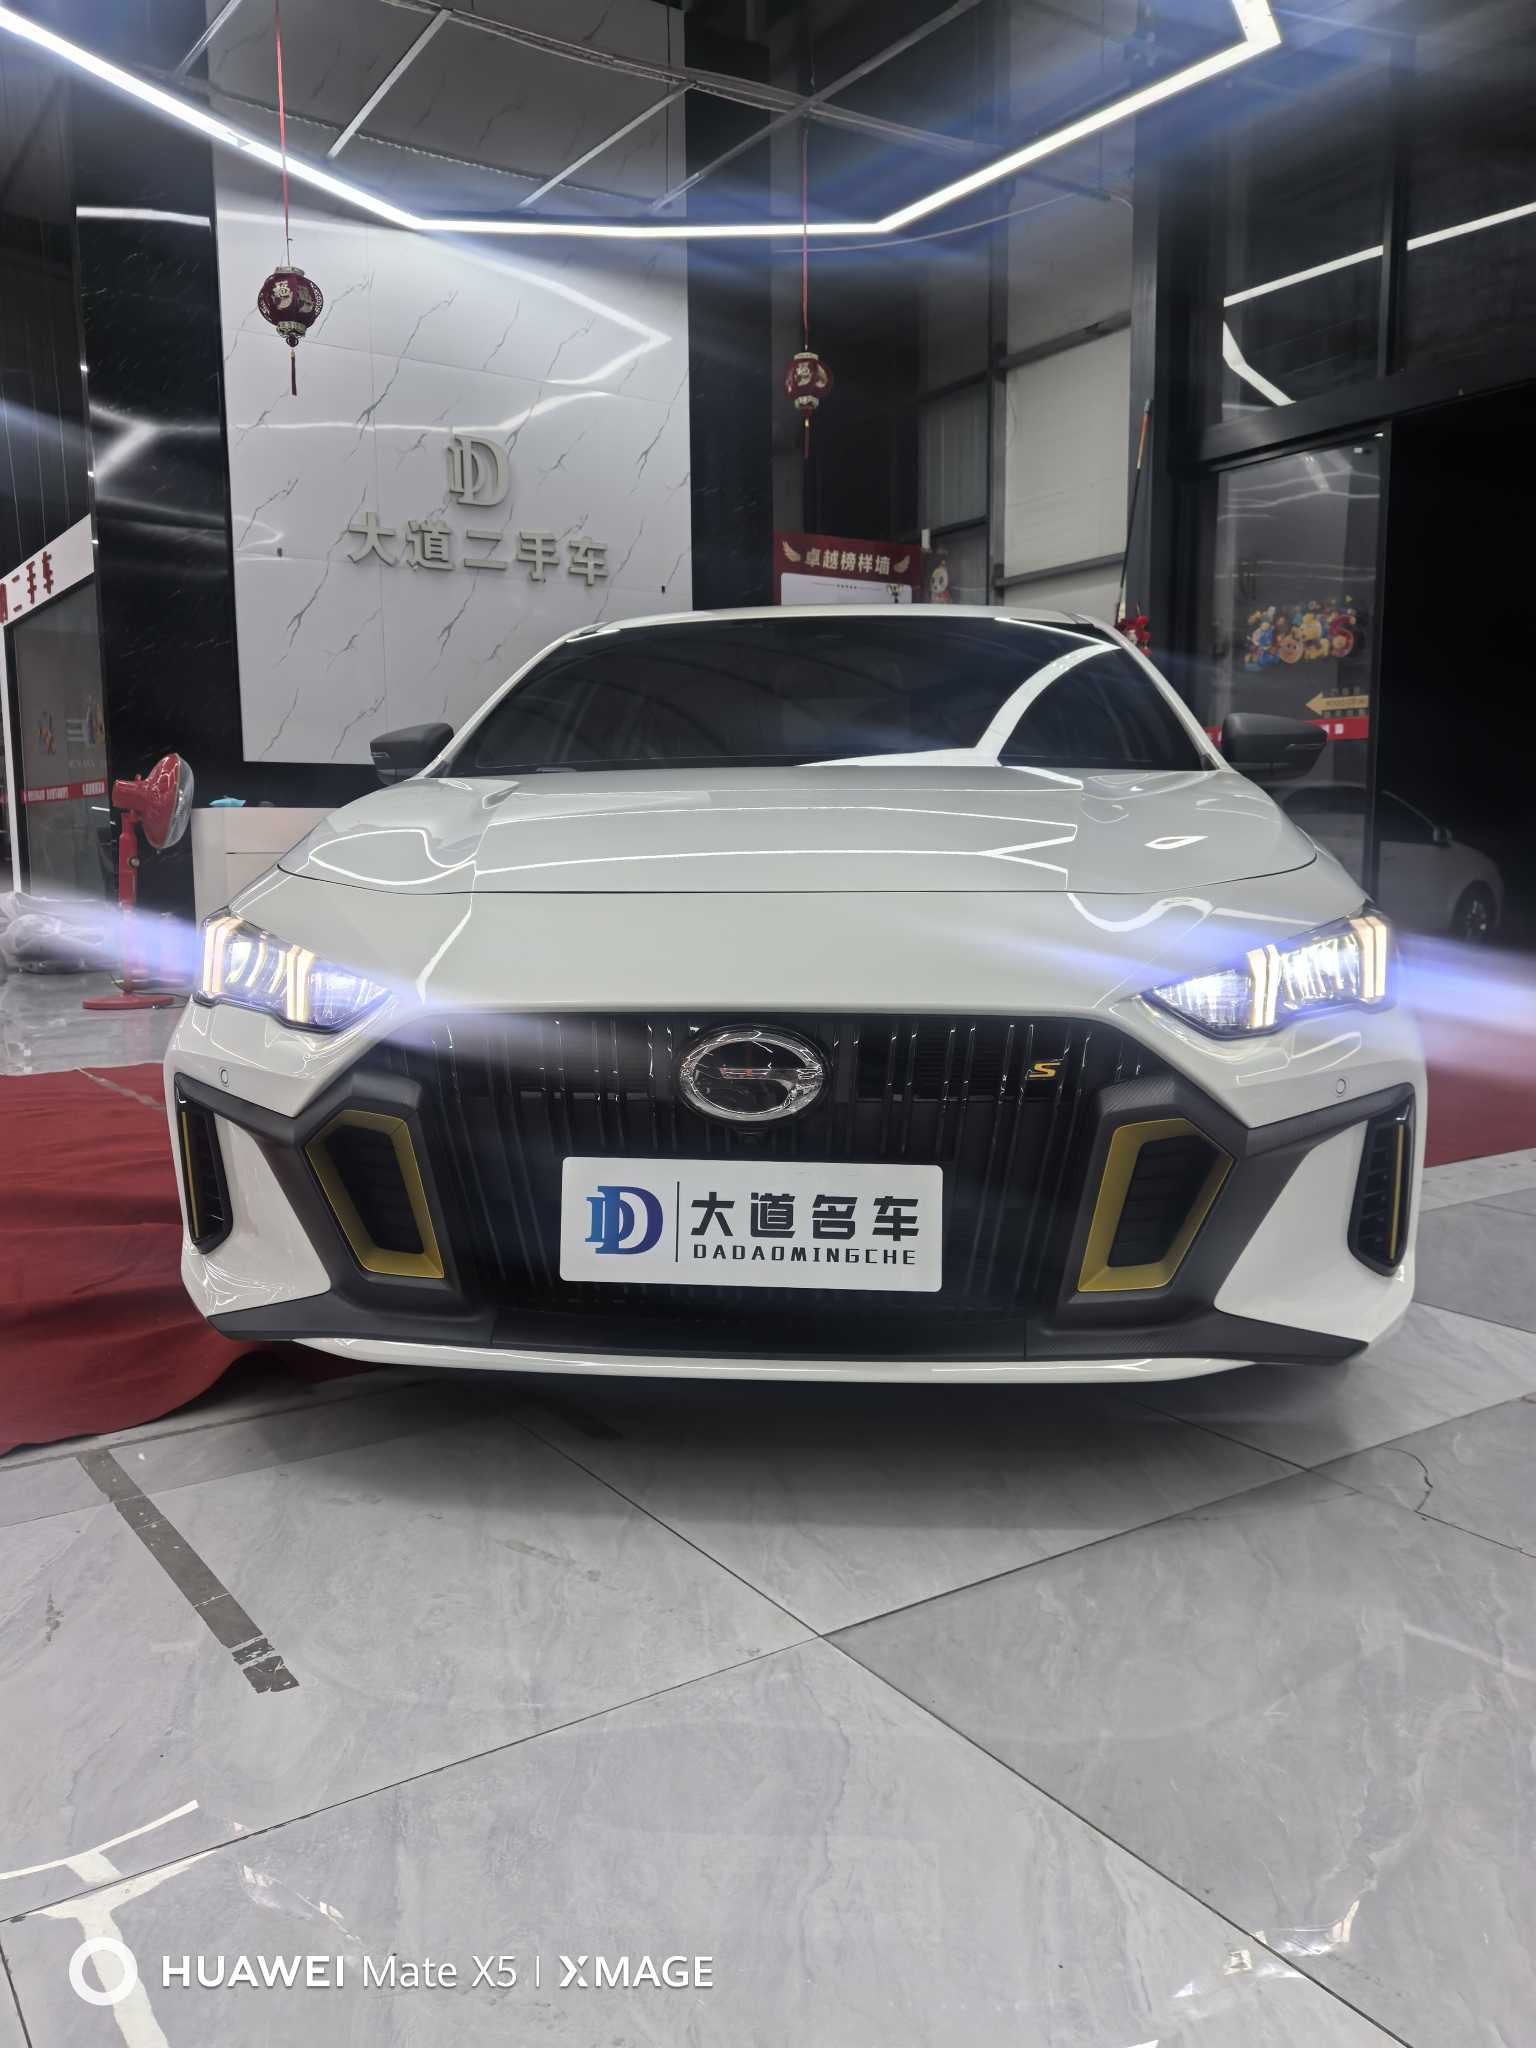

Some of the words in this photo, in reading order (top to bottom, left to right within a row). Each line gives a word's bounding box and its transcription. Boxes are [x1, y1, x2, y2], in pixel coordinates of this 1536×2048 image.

[347, 511, 609, 586] 大道二手车
[805, 547, 891, 576] 卓越榜样墙
[1028, 1062, 1061, 1078] S
[689, 1190, 920, 1242] 大道名车
[693, 1244, 917, 1265] DADAOMINGCHE
